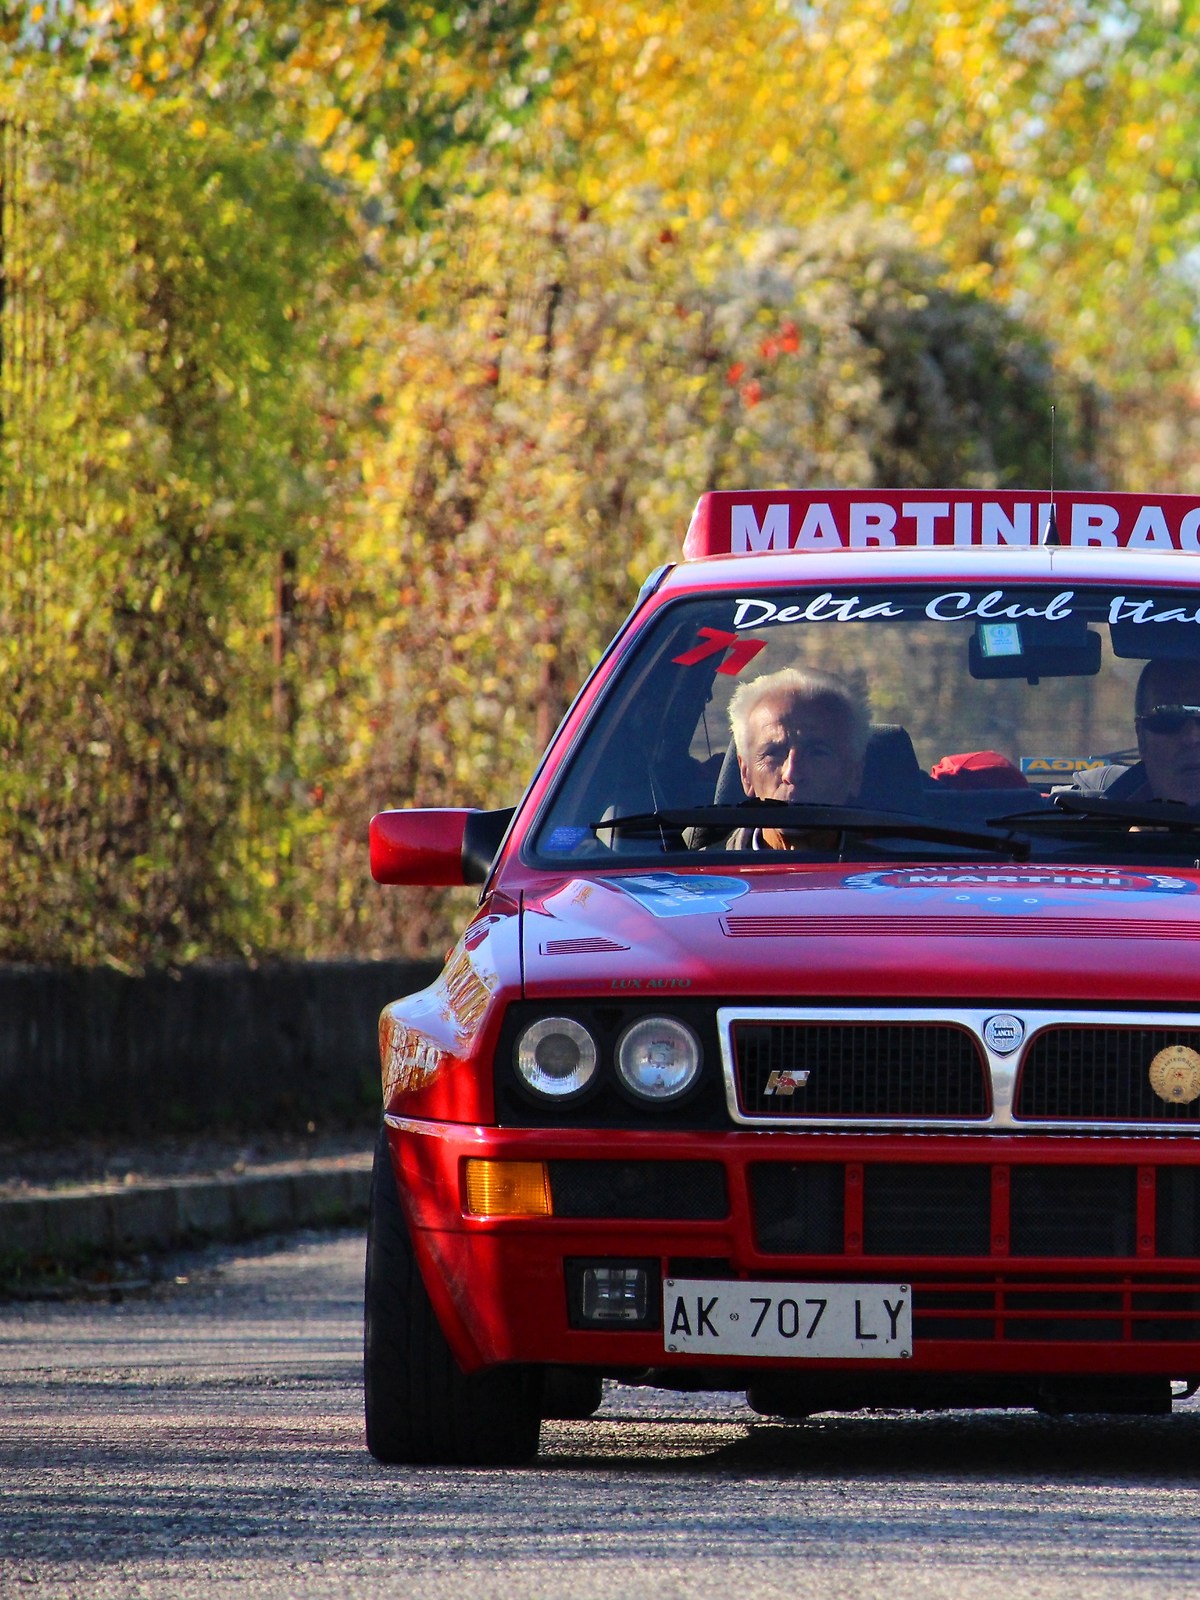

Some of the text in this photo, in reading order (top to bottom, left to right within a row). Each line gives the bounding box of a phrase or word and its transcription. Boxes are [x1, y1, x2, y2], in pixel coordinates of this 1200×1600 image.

[731, 502, 1057, 554] MARTINI
[733, 593, 904, 629] Delta
[925, 590, 1074, 621] Club
[908, 875, 1121, 885] MARTINI
[645, 978, 692, 989] AUTO
[669, 1296, 905, 1340] AK 707 LY
